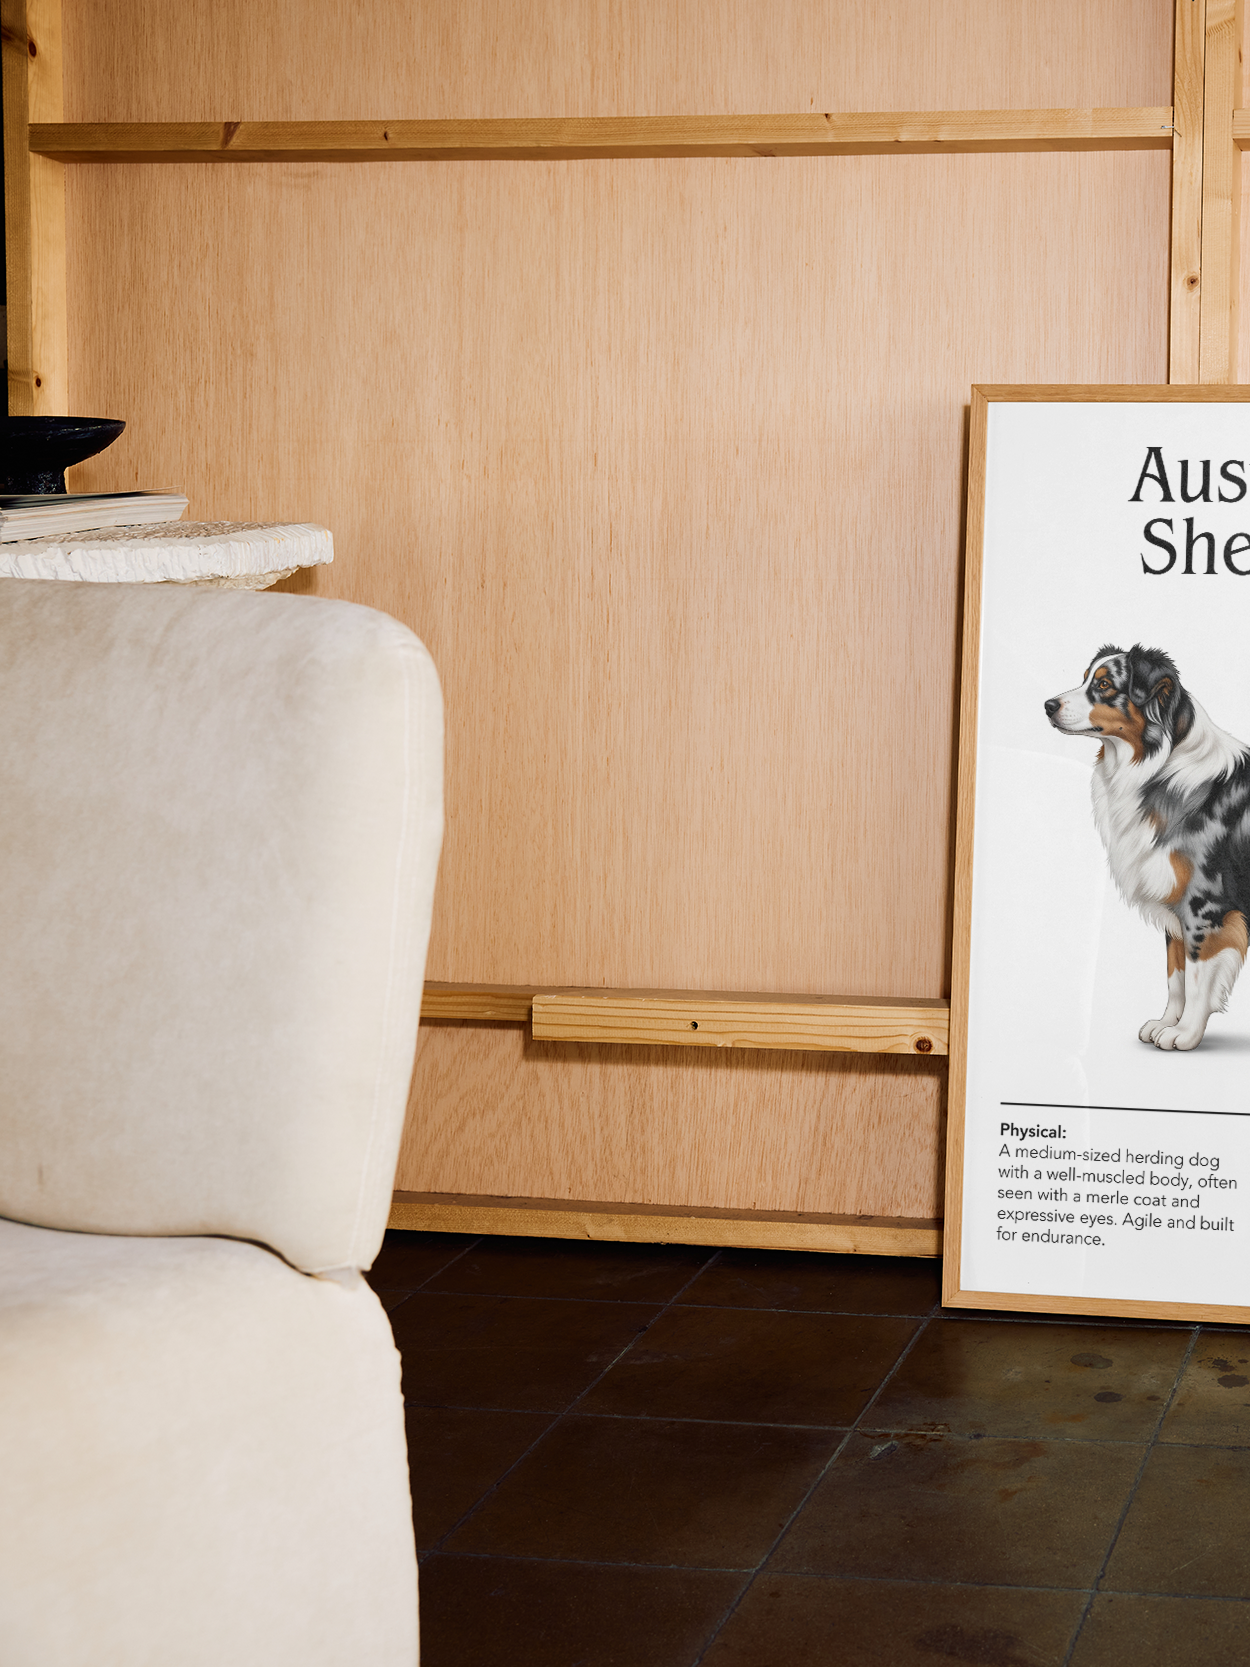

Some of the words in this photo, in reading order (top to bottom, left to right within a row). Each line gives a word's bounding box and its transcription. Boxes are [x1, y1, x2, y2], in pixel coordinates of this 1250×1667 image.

[999, 1122, 1067, 1142] Physical:
[998, 1143, 1011, 1158] A
[1015, 1144, 1121, 1163] medium-sized
[1125, 1148, 1184, 1170] herding
[1188, 1151, 1220, 1172] dog
[997, 1164, 1029, 1180] with
[1033, 1169, 1043, 1180] a
[1046, 1166, 1146, 1186] well-muscled
[1149, 1170, 1193, 1192] body,
[1197, 1173, 1238, 1190] often
[997, 1188, 1033, 1200] seen
[1037, 1187, 1068, 1202] with
[1072, 1192, 1081, 1203] a
[1086, 1189, 1129, 1206] merle
[1133, 1194, 1167, 1208] coat
[1171, 1193, 1200, 1209] and
[996, 1208, 1075, 1225] expressive
[1079, 1213, 1118, 1229] eyes.
[1121, 1212, 1163, 1231] Agile
[1166, 1214, 1196, 1230] and
[1199, 1214, 1235, 1232] built
[995, 1225, 1018, 1242] for
[1021, 1228, 1106, 1247] endurance.
